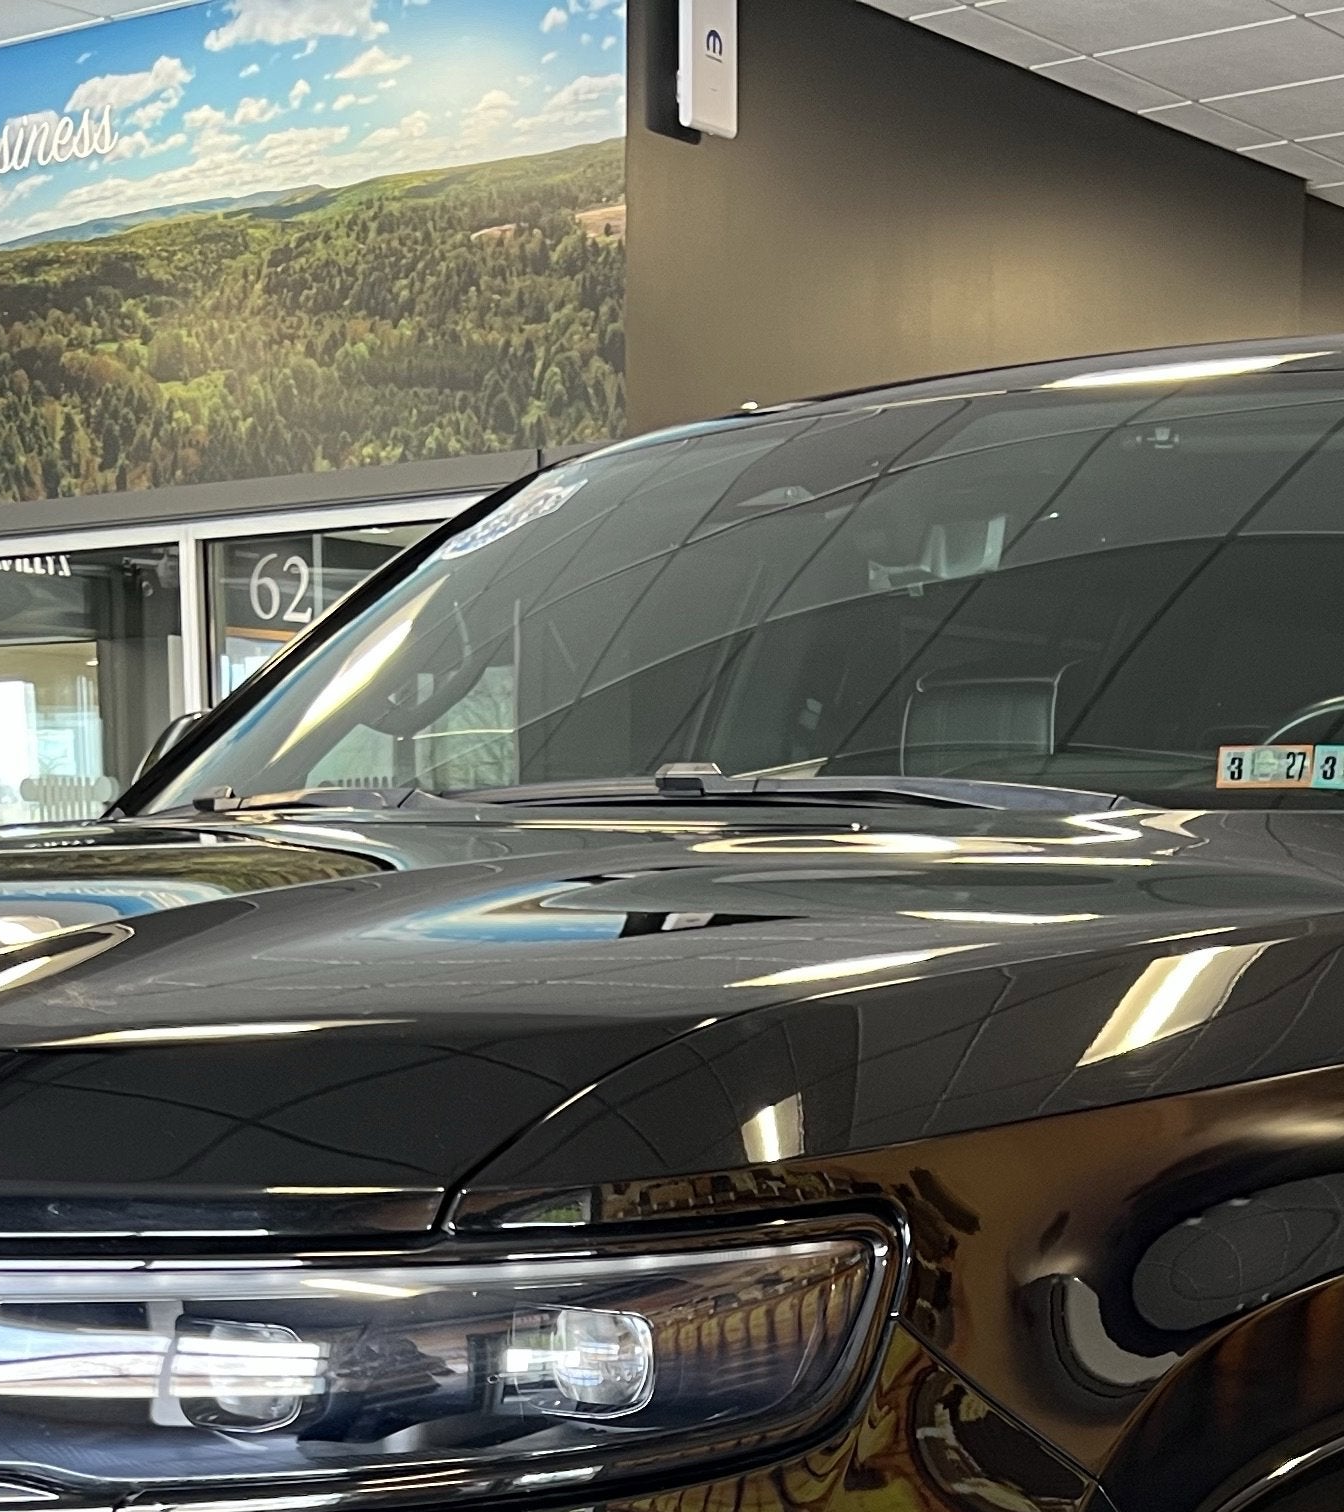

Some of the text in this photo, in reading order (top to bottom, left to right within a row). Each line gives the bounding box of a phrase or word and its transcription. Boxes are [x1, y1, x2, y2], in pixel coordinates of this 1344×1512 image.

[249, 553, 313, 624] 62
[1229, 752, 1307, 783] 3 27
[1321, 756, 1337, 781] 3
